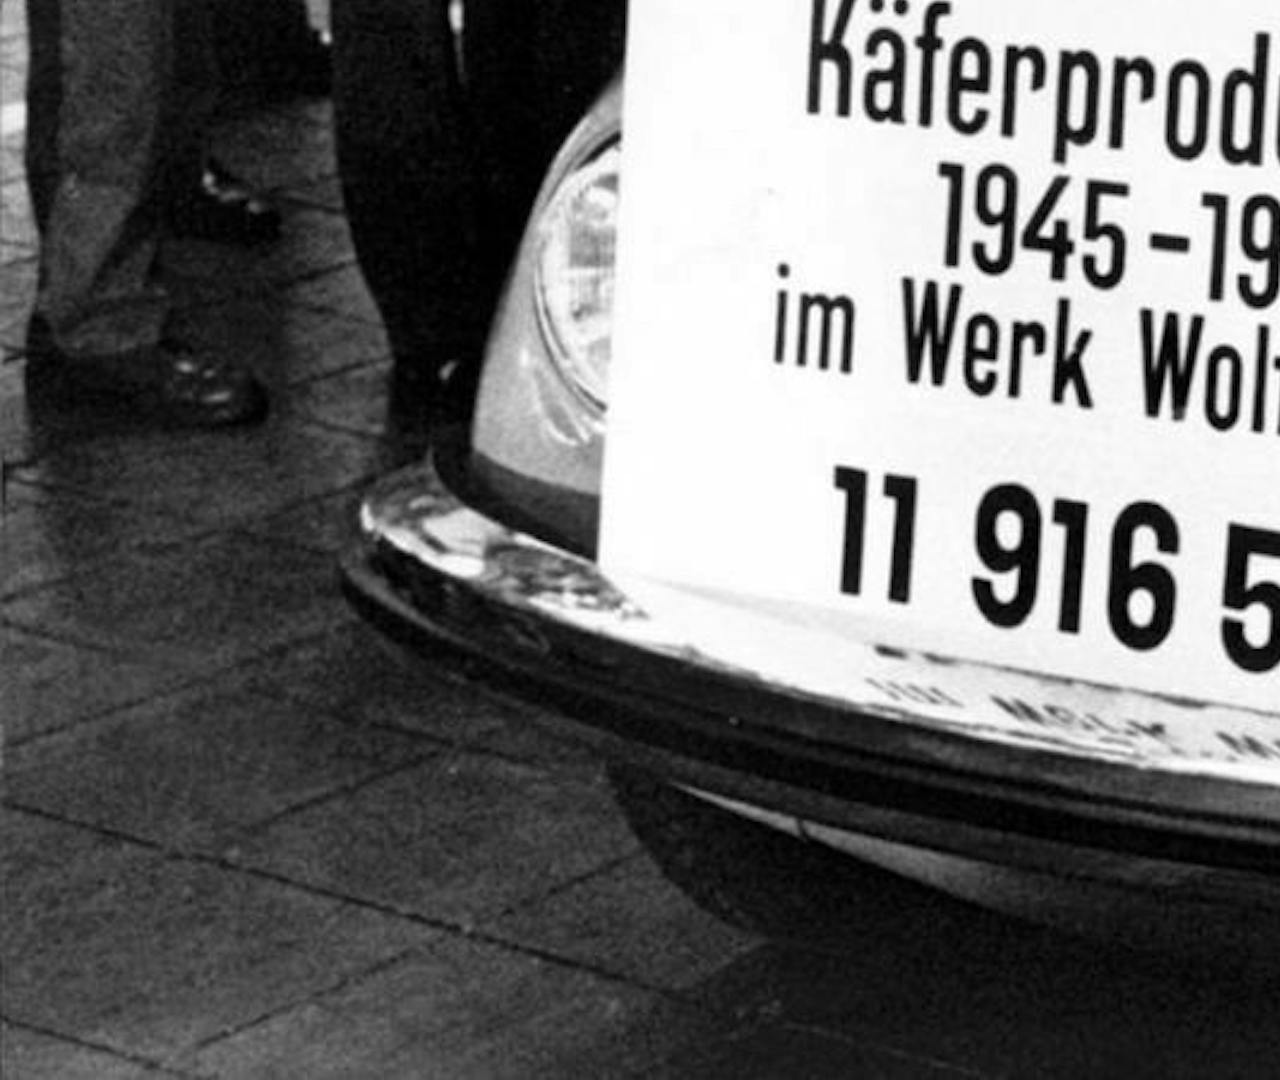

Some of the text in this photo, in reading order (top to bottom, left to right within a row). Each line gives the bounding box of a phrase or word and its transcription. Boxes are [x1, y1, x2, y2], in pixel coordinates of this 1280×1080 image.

[773, 262, 856, 375] im
[901, 276, 1094, 410] Werk
[833, 464, 919, 605] 11
[970, 481, 1181, 653] 916
